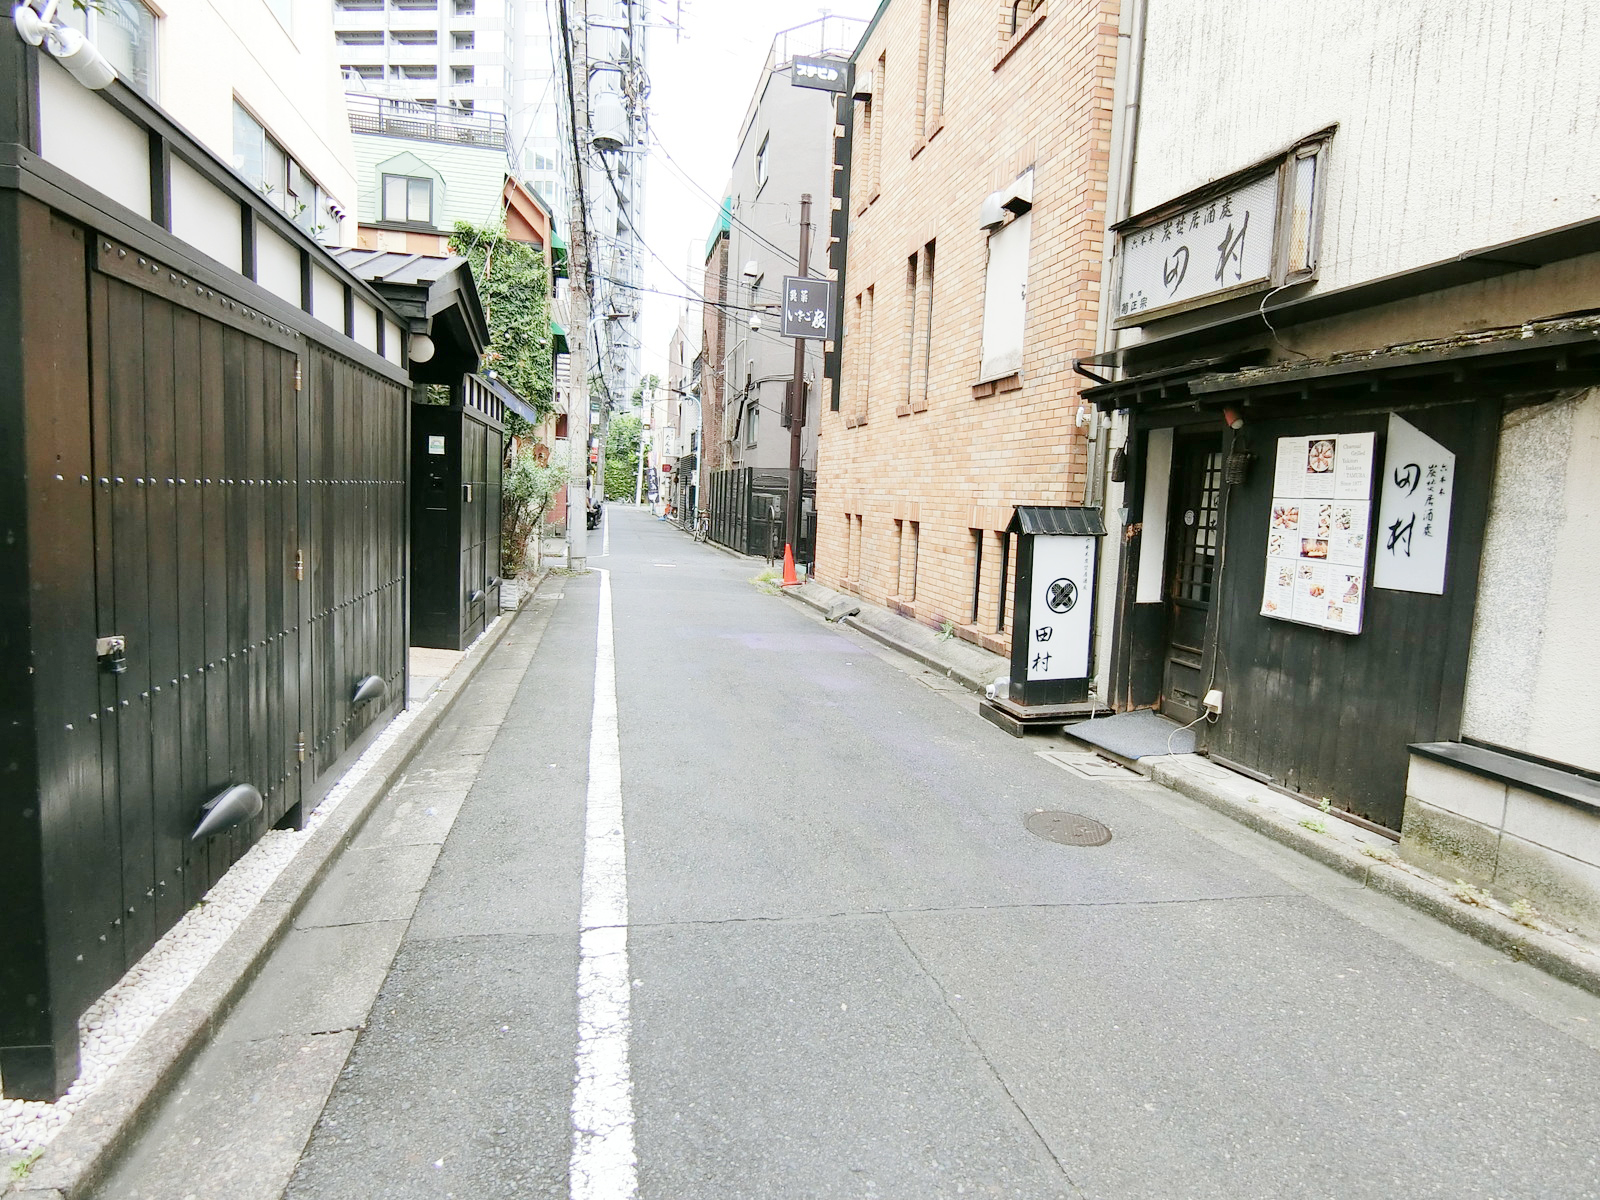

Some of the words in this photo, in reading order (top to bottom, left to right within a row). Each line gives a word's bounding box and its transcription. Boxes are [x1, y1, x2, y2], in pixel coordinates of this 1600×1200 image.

[1163, 210, 1250, 298] 田村
[1386, 463, 1422, 558] 田村
[1438, 463, 1448, 496] 六本木
[1032, 626, 1053, 672] 田村
